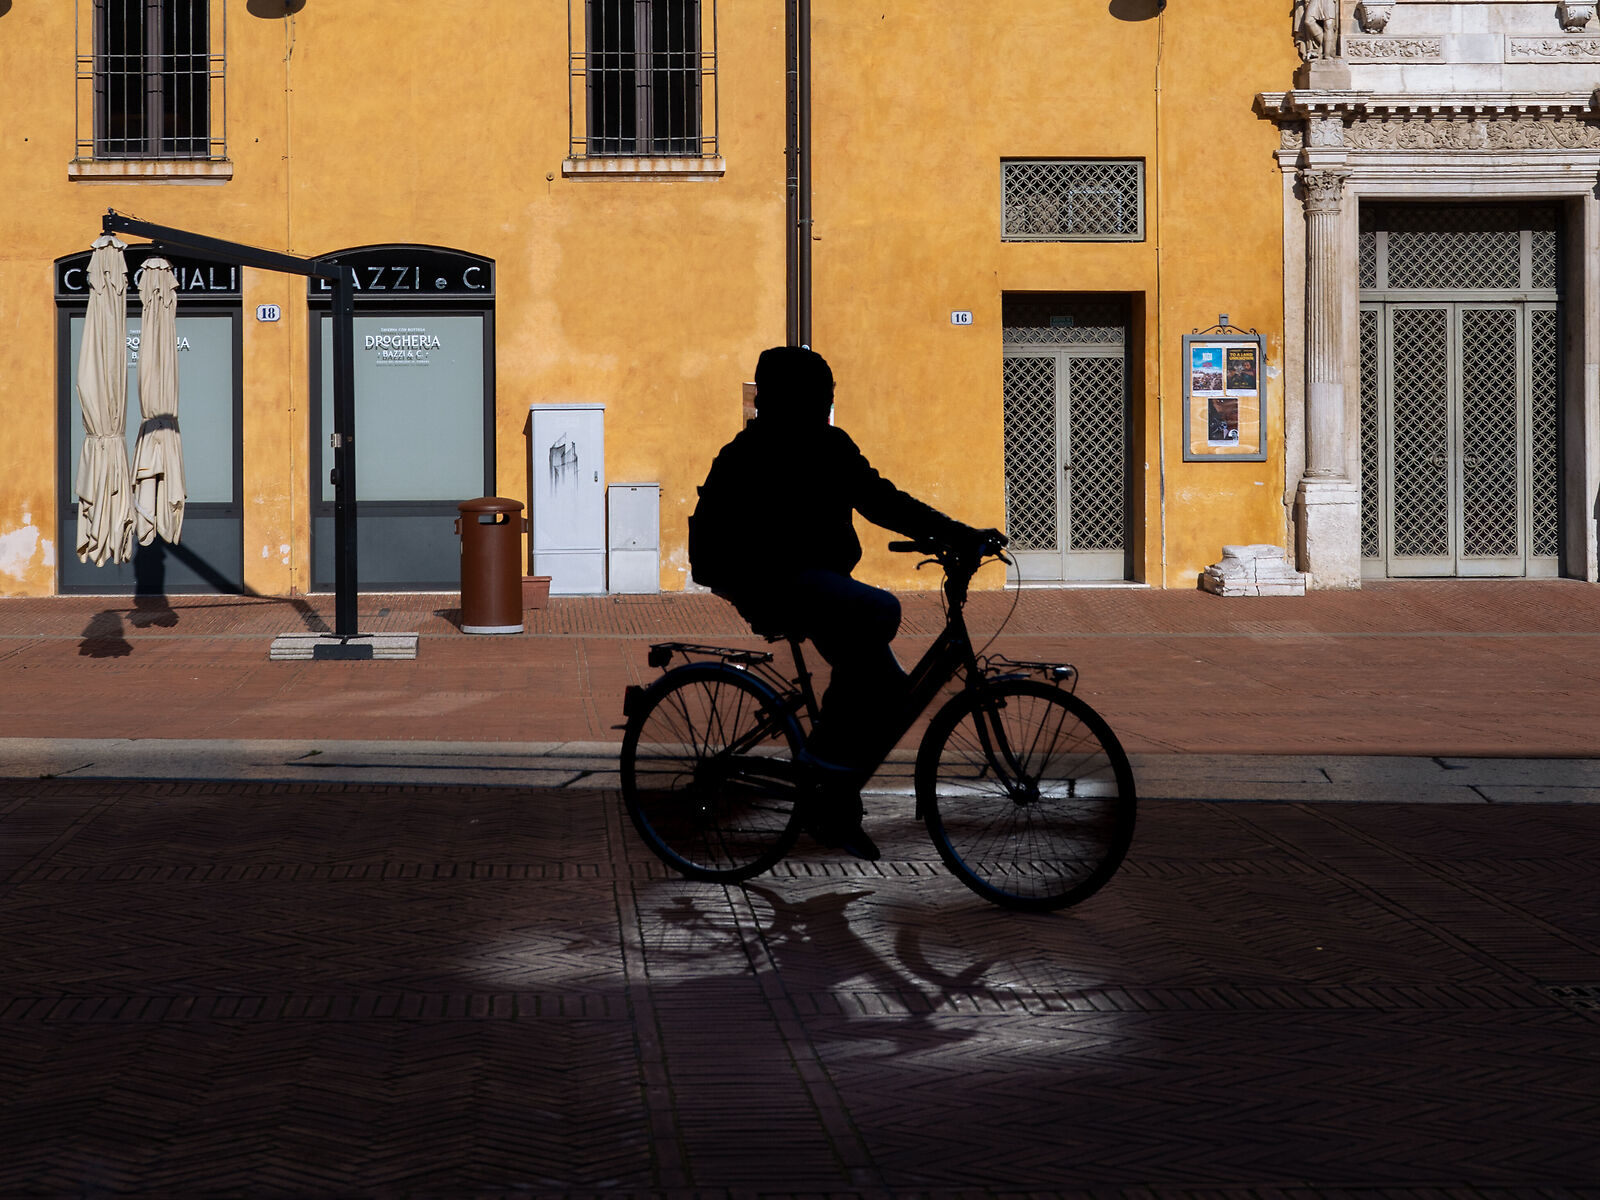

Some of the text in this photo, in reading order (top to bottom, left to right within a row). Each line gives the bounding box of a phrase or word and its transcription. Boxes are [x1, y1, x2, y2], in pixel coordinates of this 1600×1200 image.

[435, 277, 447, 289] e
[462, 267, 486, 289] C.
[262, 307, 275, 319] 18
[956, 313, 967, 323] 16
[365, 335, 441, 347] DROGHERIA
